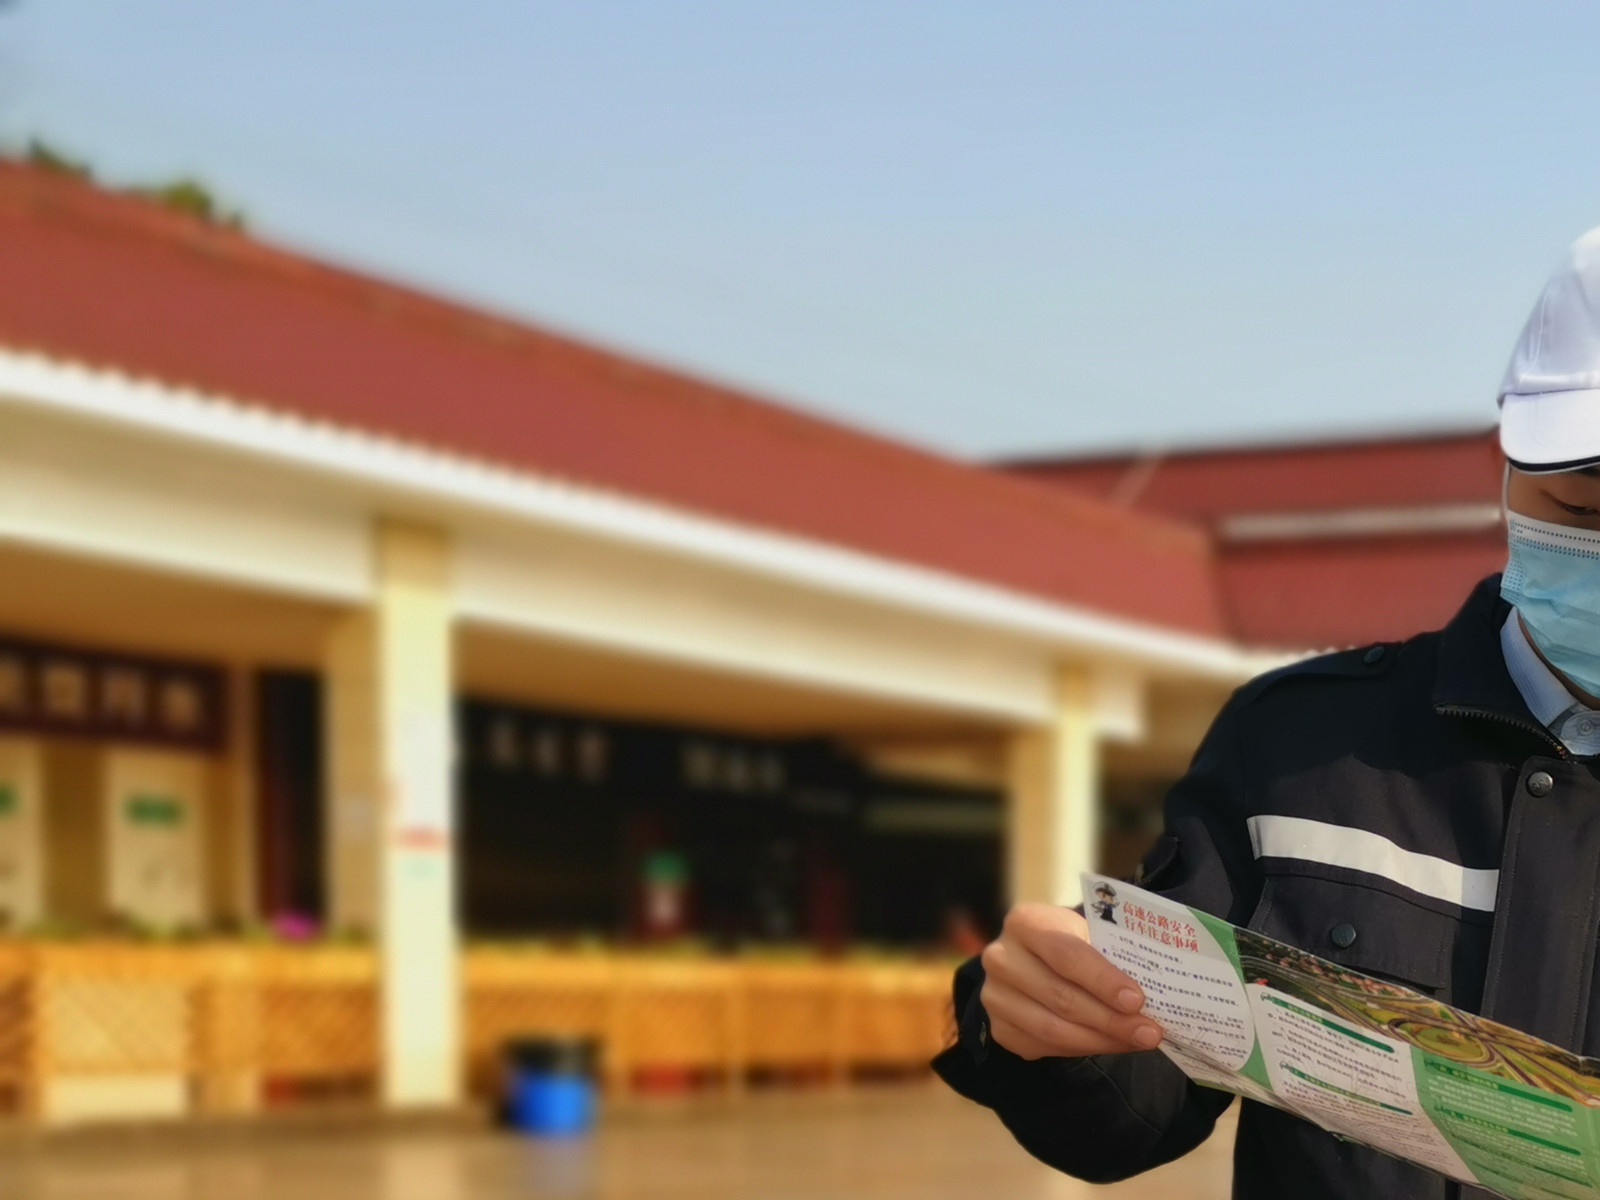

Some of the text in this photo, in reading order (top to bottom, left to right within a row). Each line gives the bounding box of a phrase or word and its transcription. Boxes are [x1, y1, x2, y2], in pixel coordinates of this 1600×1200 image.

[1122, 900, 1197, 939] 高速公路安全
[1124, 915, 1199, 954] 行车注意事项
